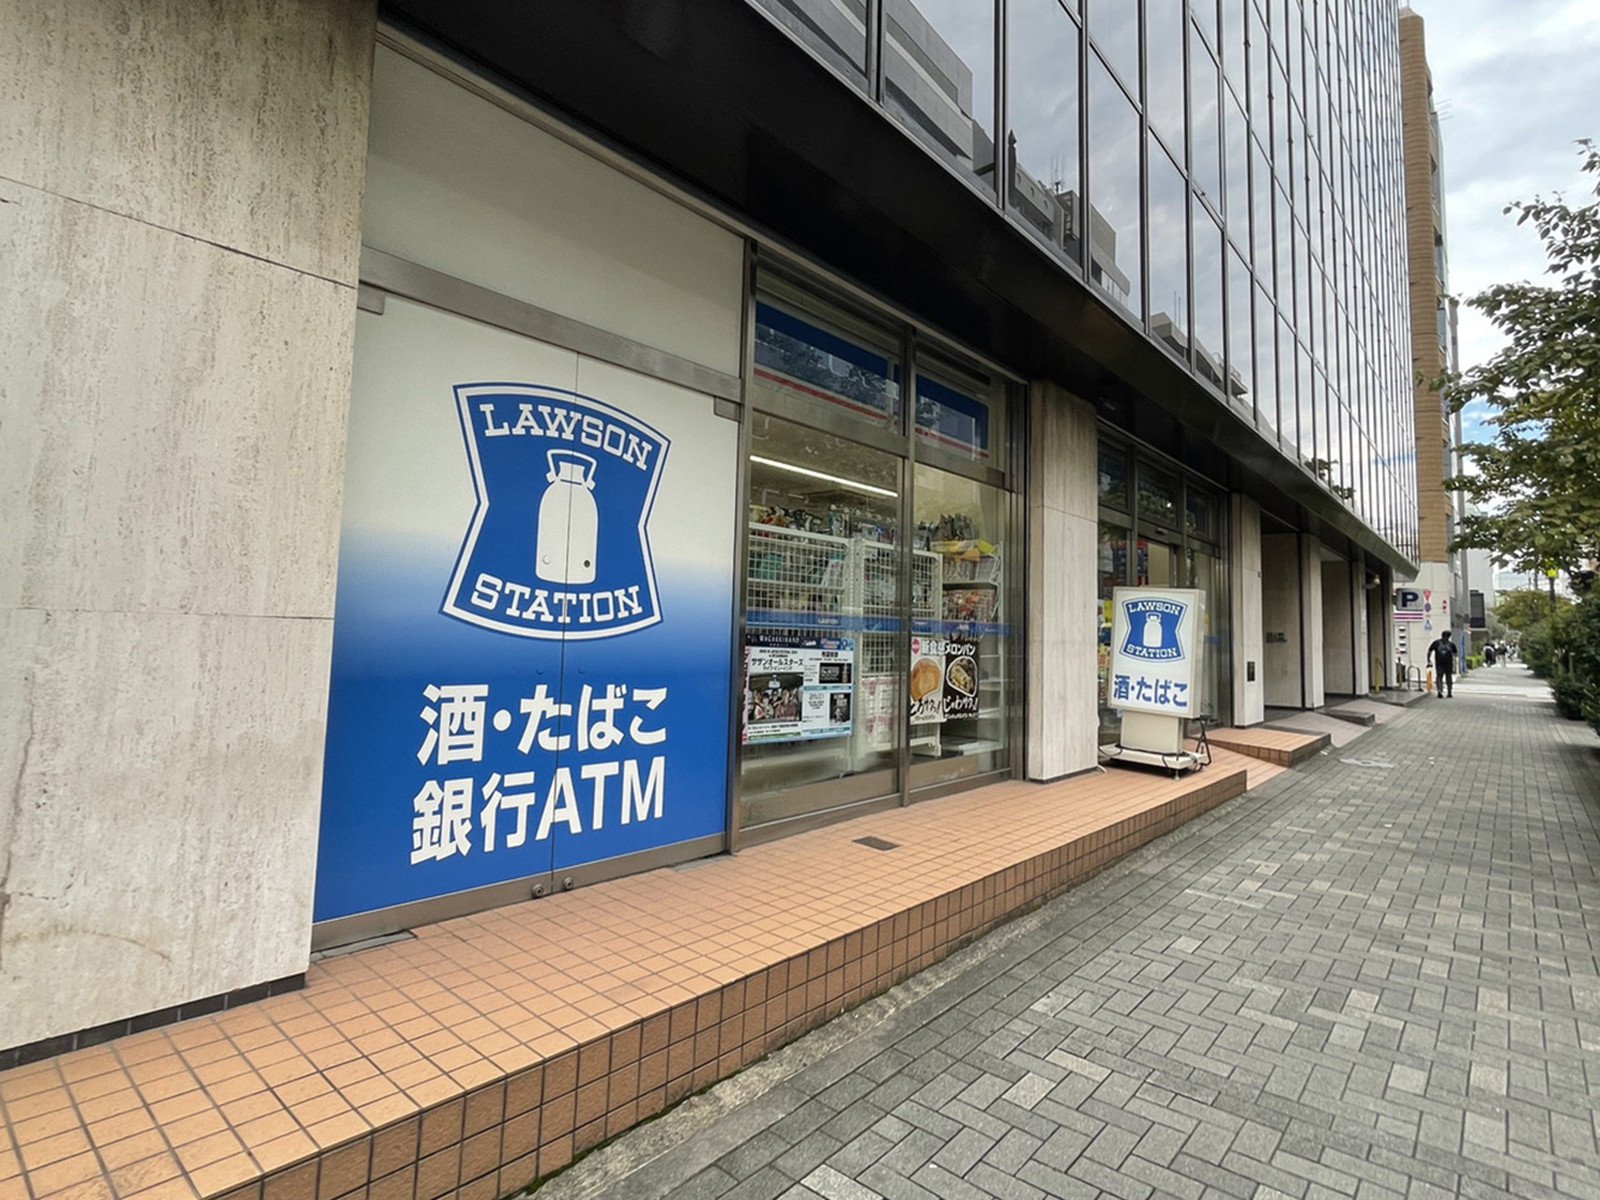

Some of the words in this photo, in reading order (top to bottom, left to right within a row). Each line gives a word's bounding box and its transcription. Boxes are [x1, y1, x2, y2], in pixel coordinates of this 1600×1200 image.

[480, 403, 653, 471] LAWSON
[470, 573, 643, 624] STATION
[1128, 601, 1181, 616] LAWSON
[1401, 591, 1419, 608] P
[1126, 644, 1178, 659] STATION
[1113, 674, 1188, 707] 酒・たばこ
[417, 683, 668, 766] 酒・たばこ
[410, 756, 666, 866] 銀行ATM
